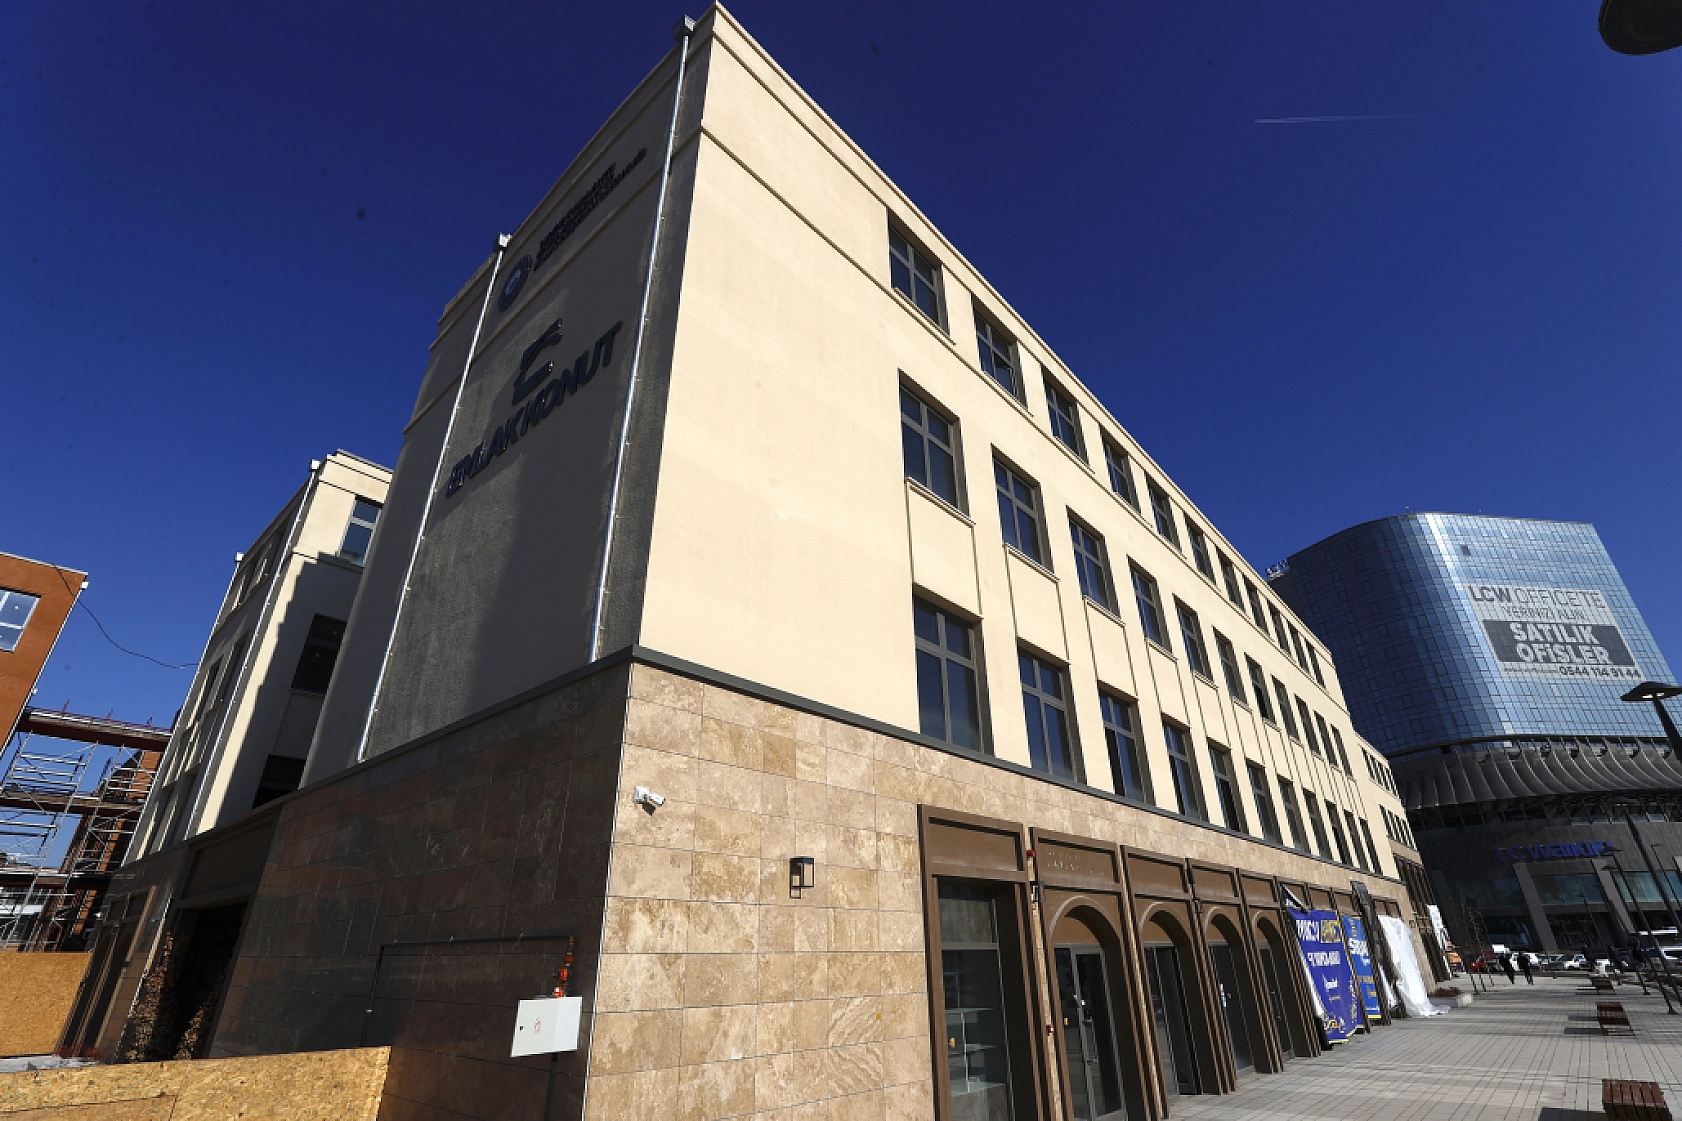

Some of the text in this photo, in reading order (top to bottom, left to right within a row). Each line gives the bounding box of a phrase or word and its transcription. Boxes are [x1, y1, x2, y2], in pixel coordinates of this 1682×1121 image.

[1469, 584, 1512, 604] LCW
[1509, 621, 1600, 645] SATILIK
[1558, 666, 1589, 677] 0544
